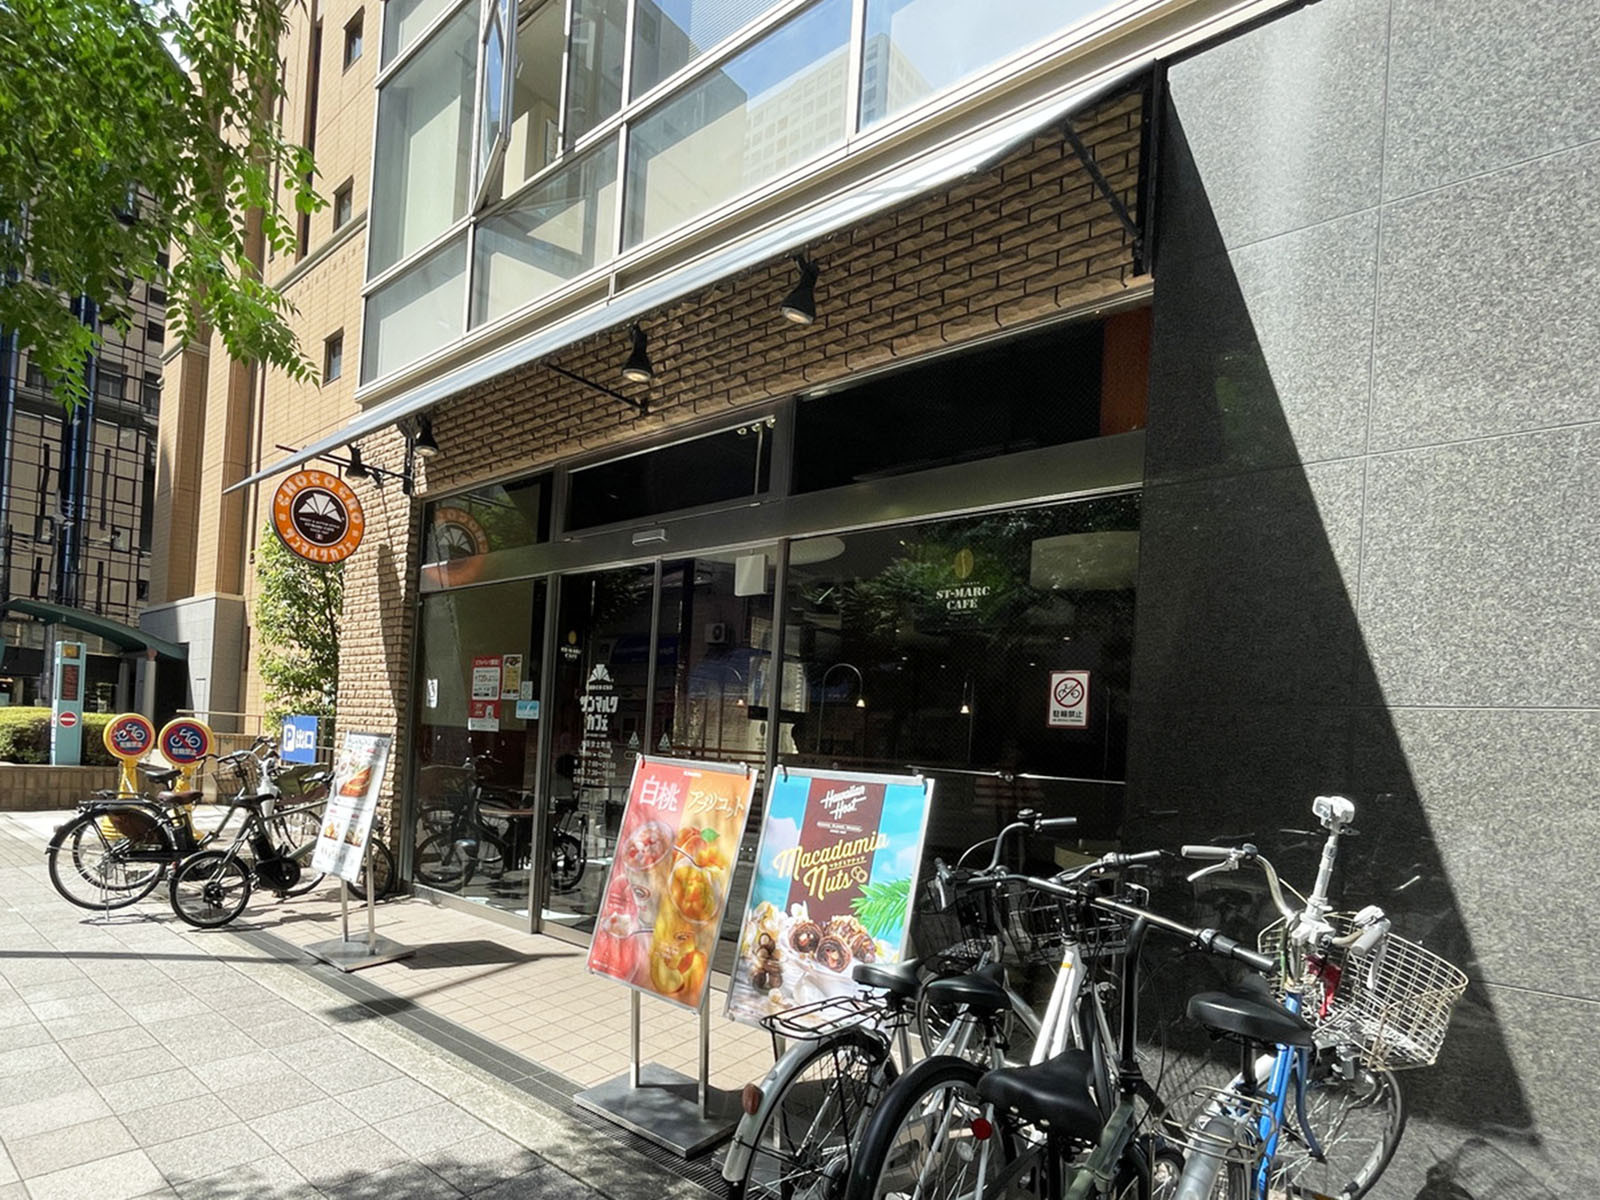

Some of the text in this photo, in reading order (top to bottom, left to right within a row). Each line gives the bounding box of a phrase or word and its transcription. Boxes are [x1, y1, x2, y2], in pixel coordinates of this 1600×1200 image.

[277, 473, 362, 524] CHOCO CRO
[936, 586, 991, 599] ST-MARC
[946, 599, 978, 610] CAFE
[579, 695, 619, 713] サンマルク
[586, 714, 609, 732] カフェ
[295, 729, 314, 749] 出口
[640, 775, 680, 812] 白桃
[688, 790, 745, 819] アプリコット
[820, 785, 866, 809] Hawaiian
[829, 796, 867, 820] Host
[772, 831, 889, 881] Macadamia
[803, 863, 854, 901] Nuts
